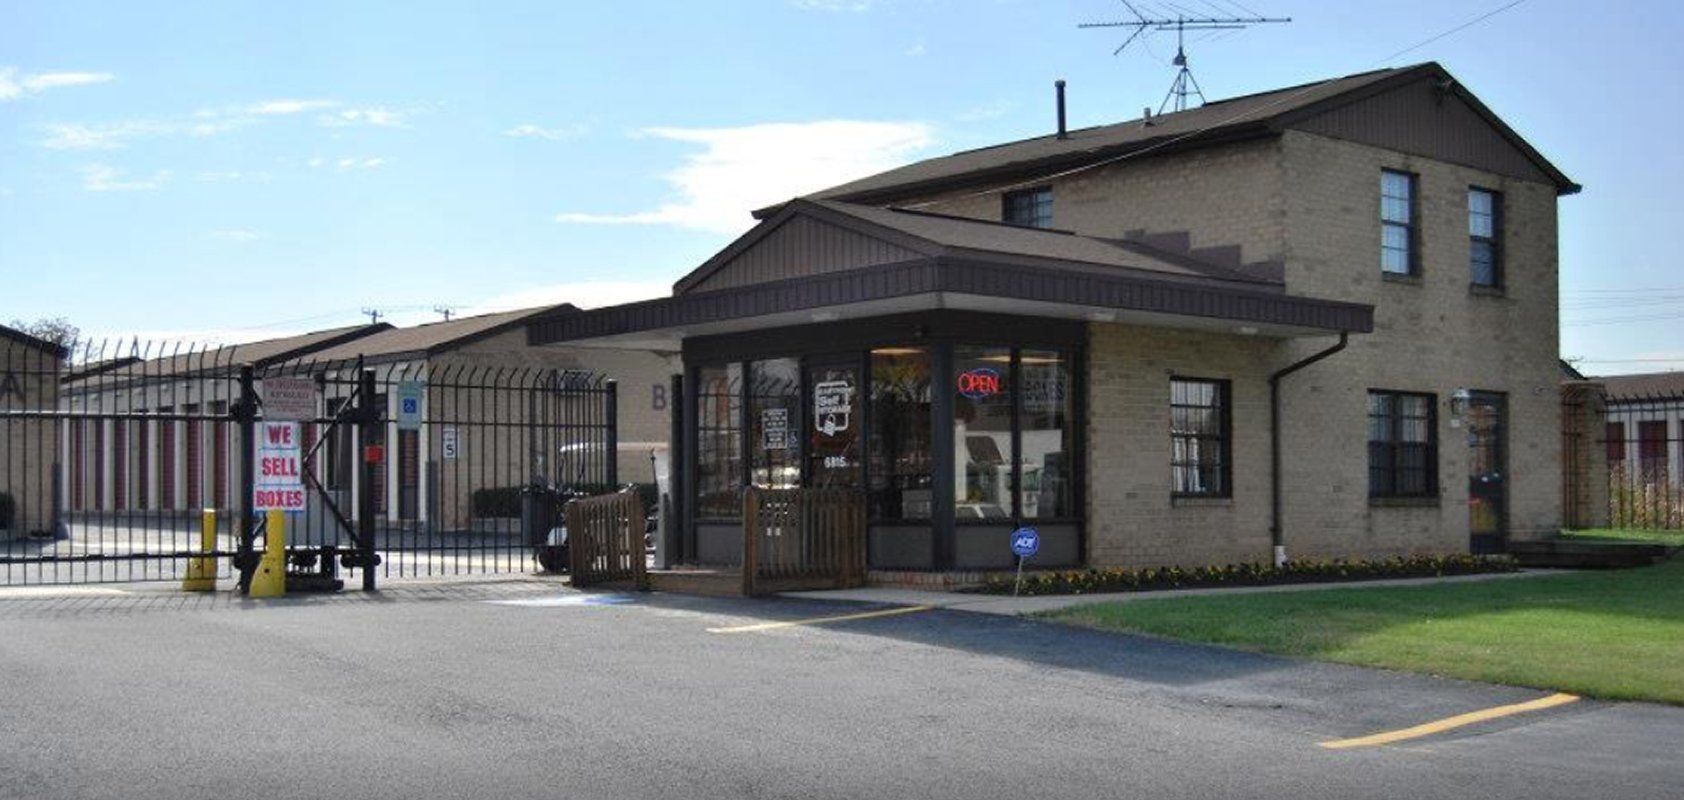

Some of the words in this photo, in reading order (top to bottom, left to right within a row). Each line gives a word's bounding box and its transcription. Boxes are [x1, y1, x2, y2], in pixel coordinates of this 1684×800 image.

[958, 371, 999, 394] OPEN
[653, 385, 666, 410] B
[268, 426, 291, 444] WE
[262, 457, 298, 476] SELL
[256, 490, 303, 508] BOXES
